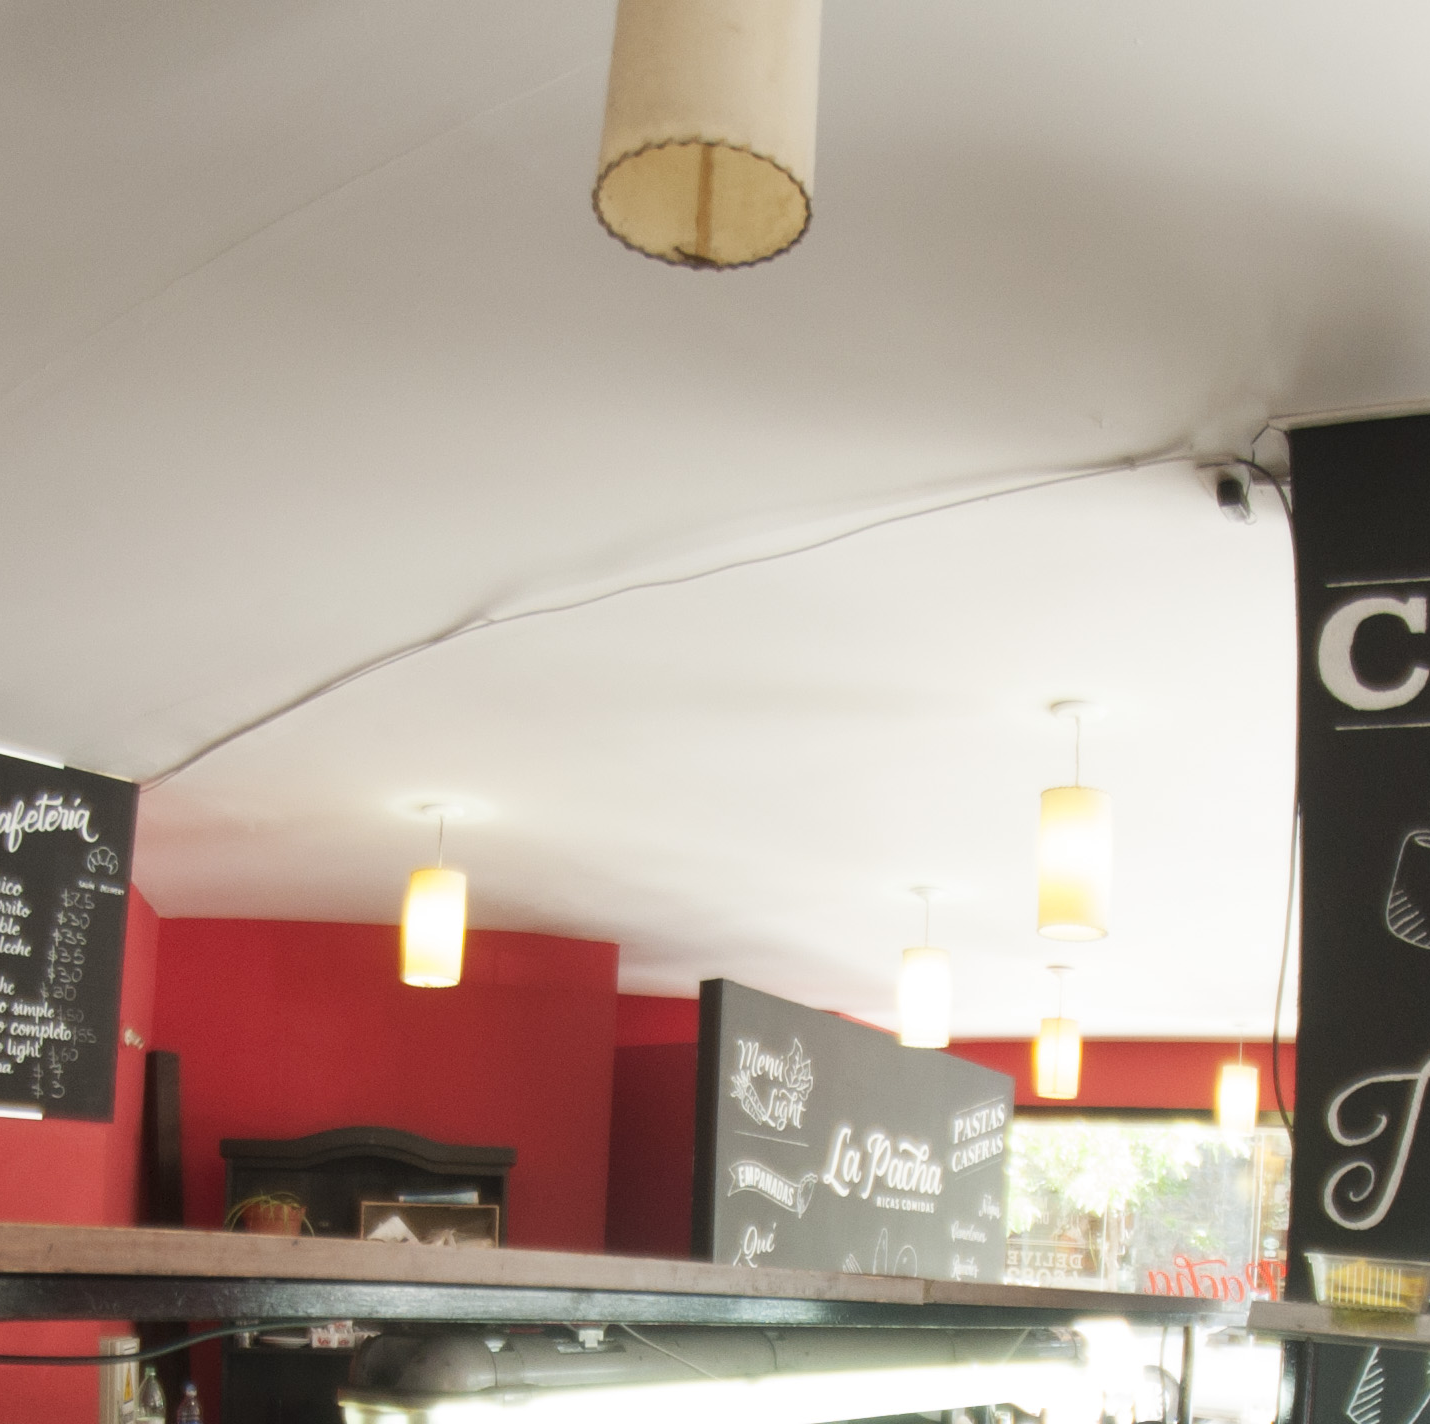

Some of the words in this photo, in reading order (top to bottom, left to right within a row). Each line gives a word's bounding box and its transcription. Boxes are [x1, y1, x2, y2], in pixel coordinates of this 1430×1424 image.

[61, 888, 96, 910] $25
[56, 910, 91, 929] $30
[52, 928, 88, 946] $35
[47, 945, 86, 966] $35
[11, 998, 55, 1023] simple
[10, 1018, 72, 1048] completo
[7, 1038, 42, 1063] light
[737, 1039, 784, 1082] Menú
[762, 1087, 807, 1131] Light
[953, 1103, 1006, 1144] PASTAS
[822, 1127, 862, 1197] La
[861, 1132, 943, 1200] Pacha
[951, 1133, 1003, 1173] CASERAS
[737, 1164, 795, 1206] EMPANADAS
[876, 1196, 900, 1210] RICAS
[902, 1199, 935, 1213] COMIDAS
